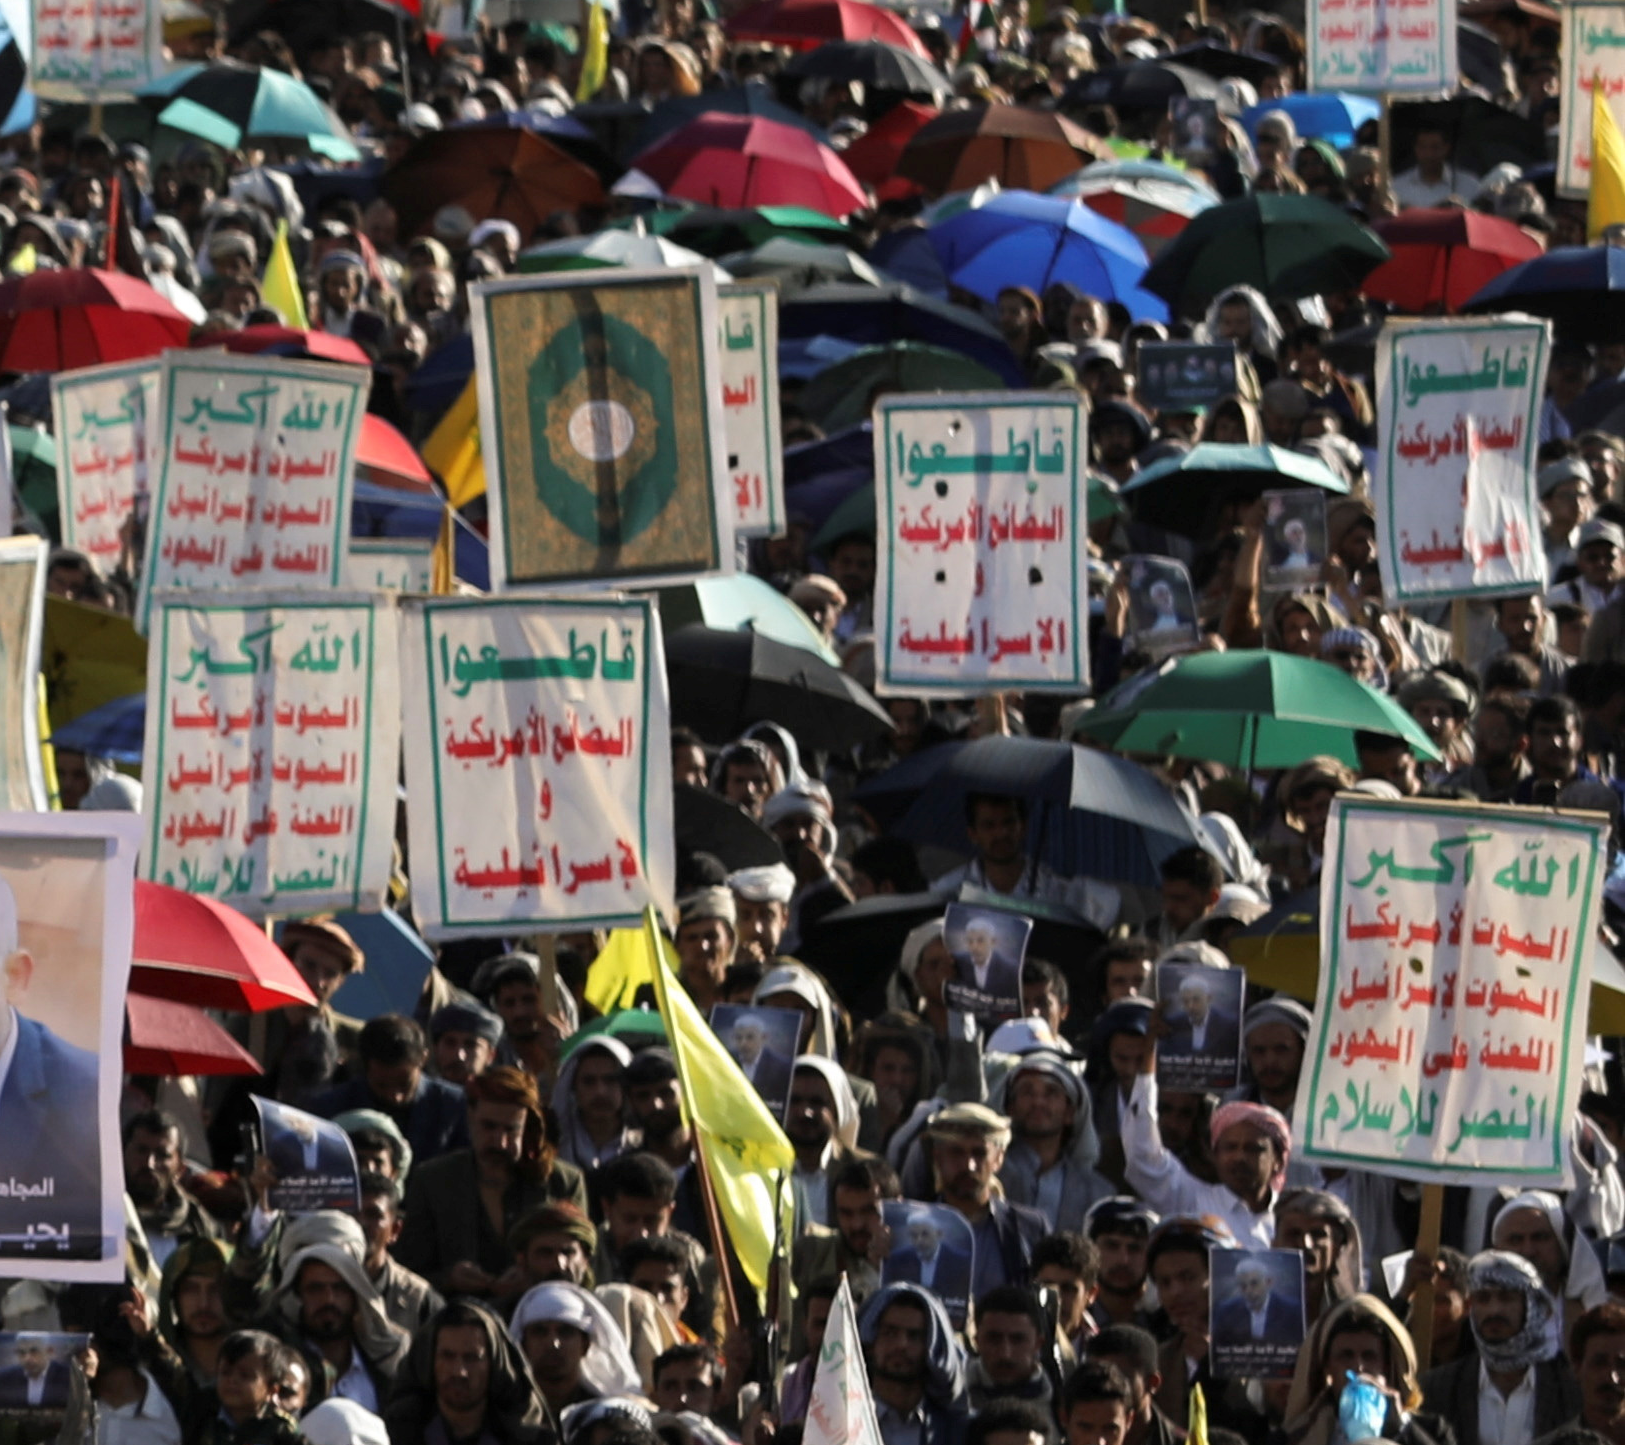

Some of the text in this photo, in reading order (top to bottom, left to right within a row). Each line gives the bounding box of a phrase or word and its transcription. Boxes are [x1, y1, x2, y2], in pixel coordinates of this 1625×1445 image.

[898, 428, 1065, 491] قاطعوا
[899, 500, 1064, 552] البضائع الأمريكية
[176, 619, 361, 686] الله أكبر
[440, 630, 636, 698] قاطعوا
[900, 619, 1066, 664] الإسرائيلية
[172, 696, 358, 736] الموت لأمريكا
[445, 704, 635, 769] البضائع الأمريكية
[168, 755, 356, 793] الموت لإسرائيل
[539, 781, 553, 821] و
[164, 804, 355, 847] اللعنة على اليهود
[263, 847, 353, 902] النصر
[1348, 824, 1580, 897] الله أكبر
[1348, 902, 1570, 962] الموت لأمريكا
[1338, 959, 1562, 1020] الموت لإسرائيل
[1328, 1026, 1557, 1077] اللعنة على اليهود
[1321, 1081, 1549, 1154] النصر للإسلام
